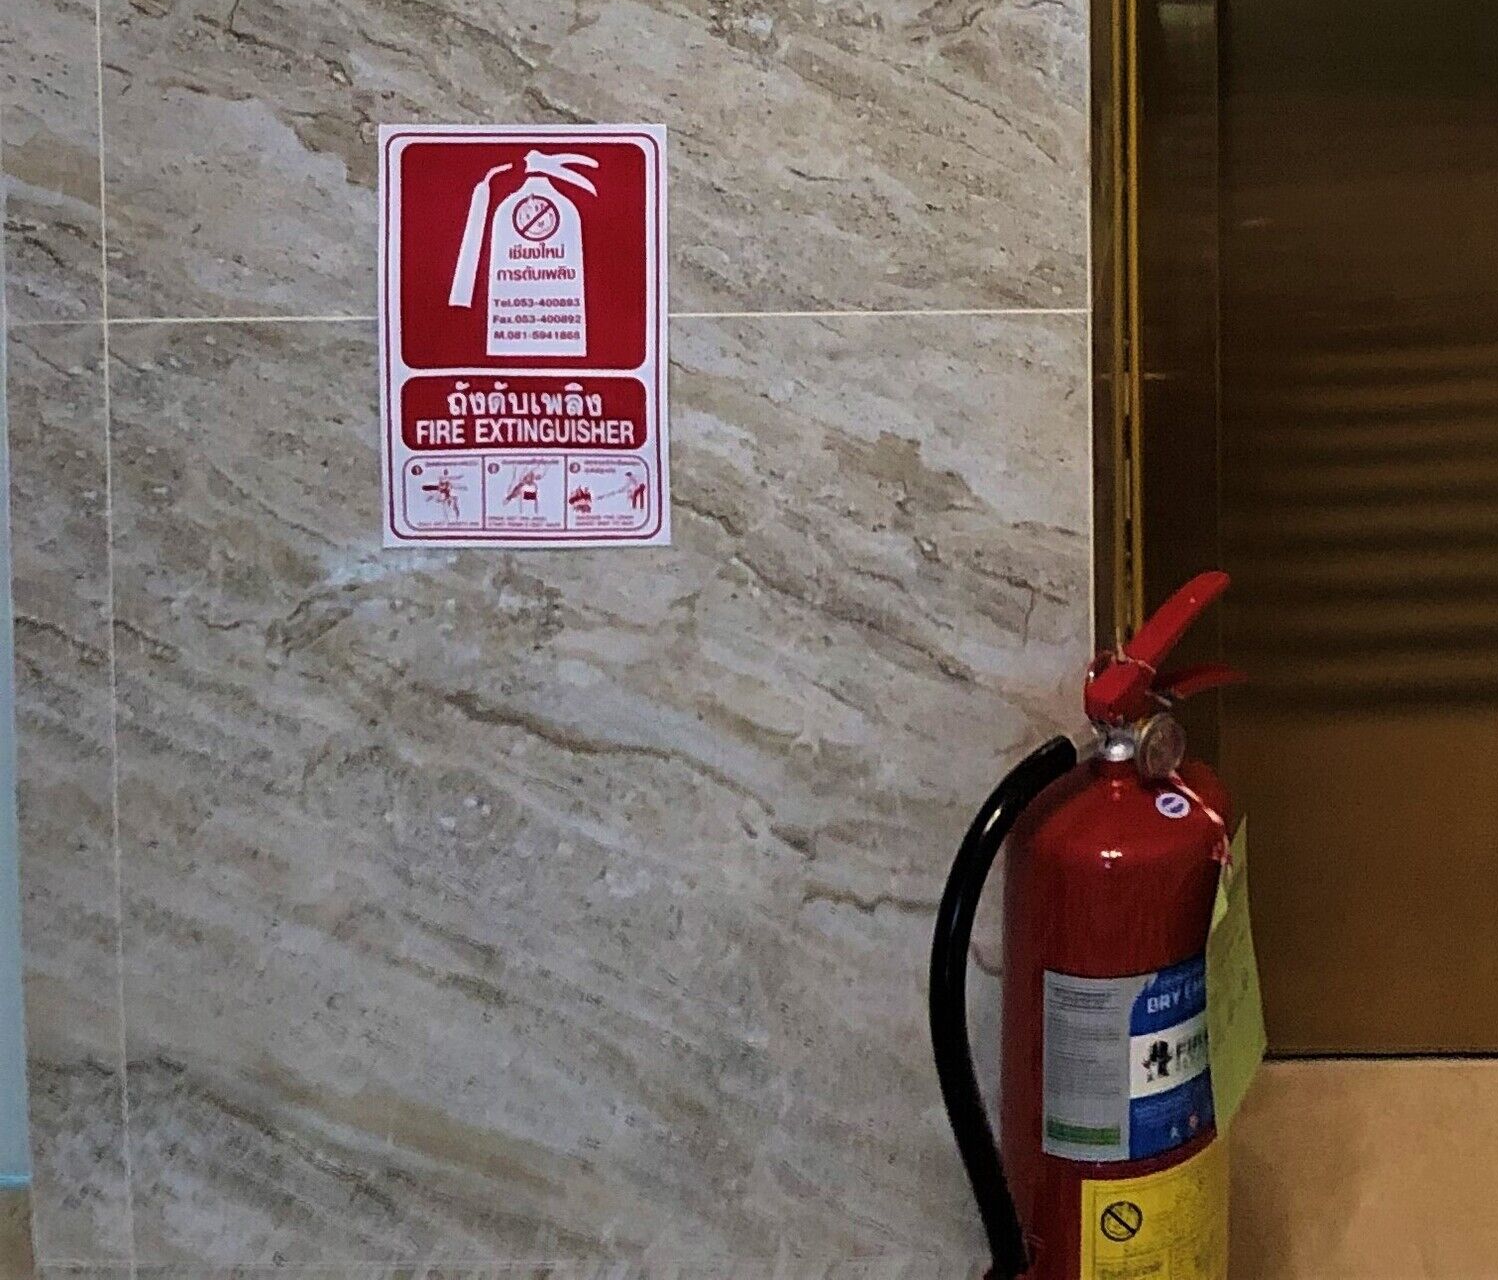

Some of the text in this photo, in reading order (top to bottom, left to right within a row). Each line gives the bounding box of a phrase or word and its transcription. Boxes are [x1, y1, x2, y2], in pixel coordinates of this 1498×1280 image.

[496, 265, 577, 282] การดับเพลิง
[447, 380, 603, 417] ถังดับเพลิง
[415, 417, 635, 445] FIRE EXTINGUISHER
